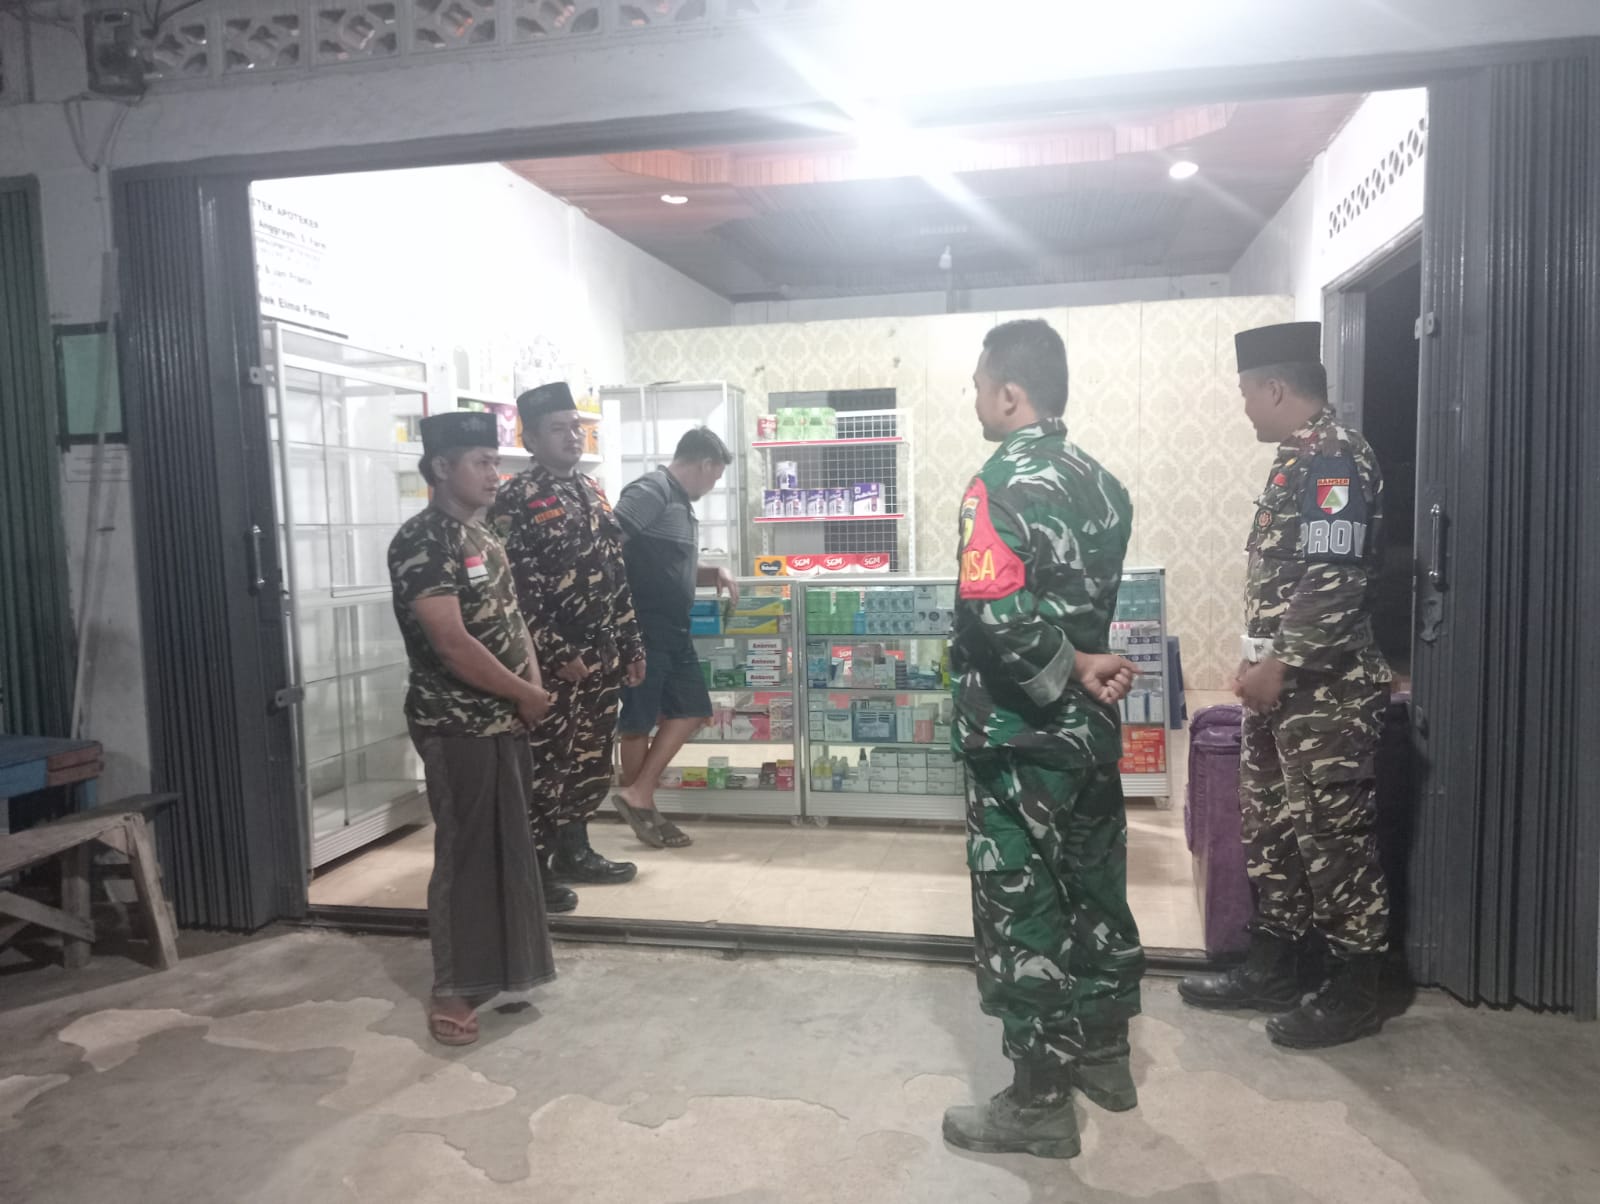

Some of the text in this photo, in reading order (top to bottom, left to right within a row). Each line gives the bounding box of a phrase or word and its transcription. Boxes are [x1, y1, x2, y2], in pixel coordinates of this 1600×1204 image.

[793, 557, 811, 567] SGM
[825, 557, 843, 567] SGM
[863, 556, 881, 565] SGM
